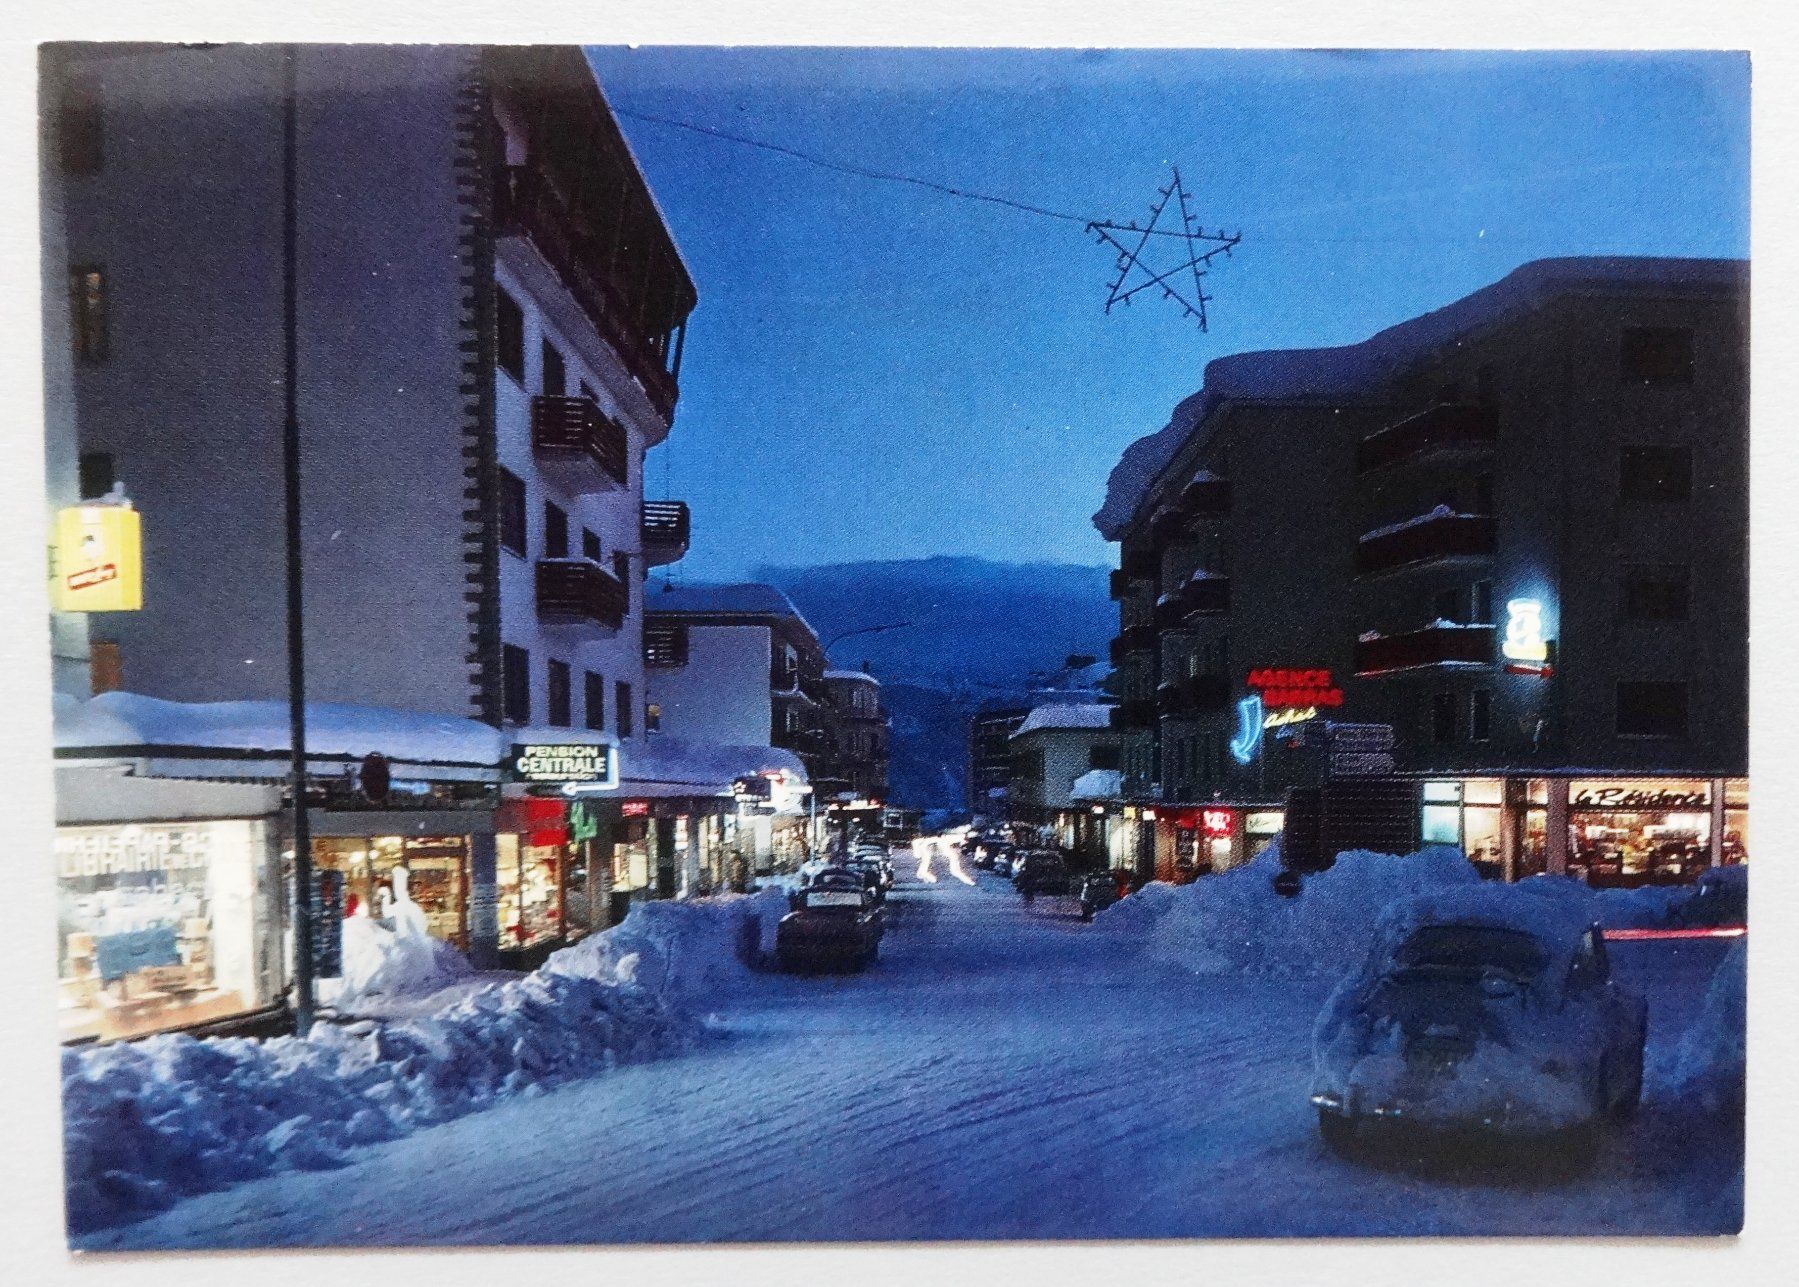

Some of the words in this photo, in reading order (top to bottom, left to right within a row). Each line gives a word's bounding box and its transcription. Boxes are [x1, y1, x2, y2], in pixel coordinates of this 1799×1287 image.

[1247, 669, 1331, 688] AGENCE
[1263, 688, 1344, 706] BARRAS
[525, 746, 598, 757] PENSION
[517, 757, 606, 773] CENTRALE
